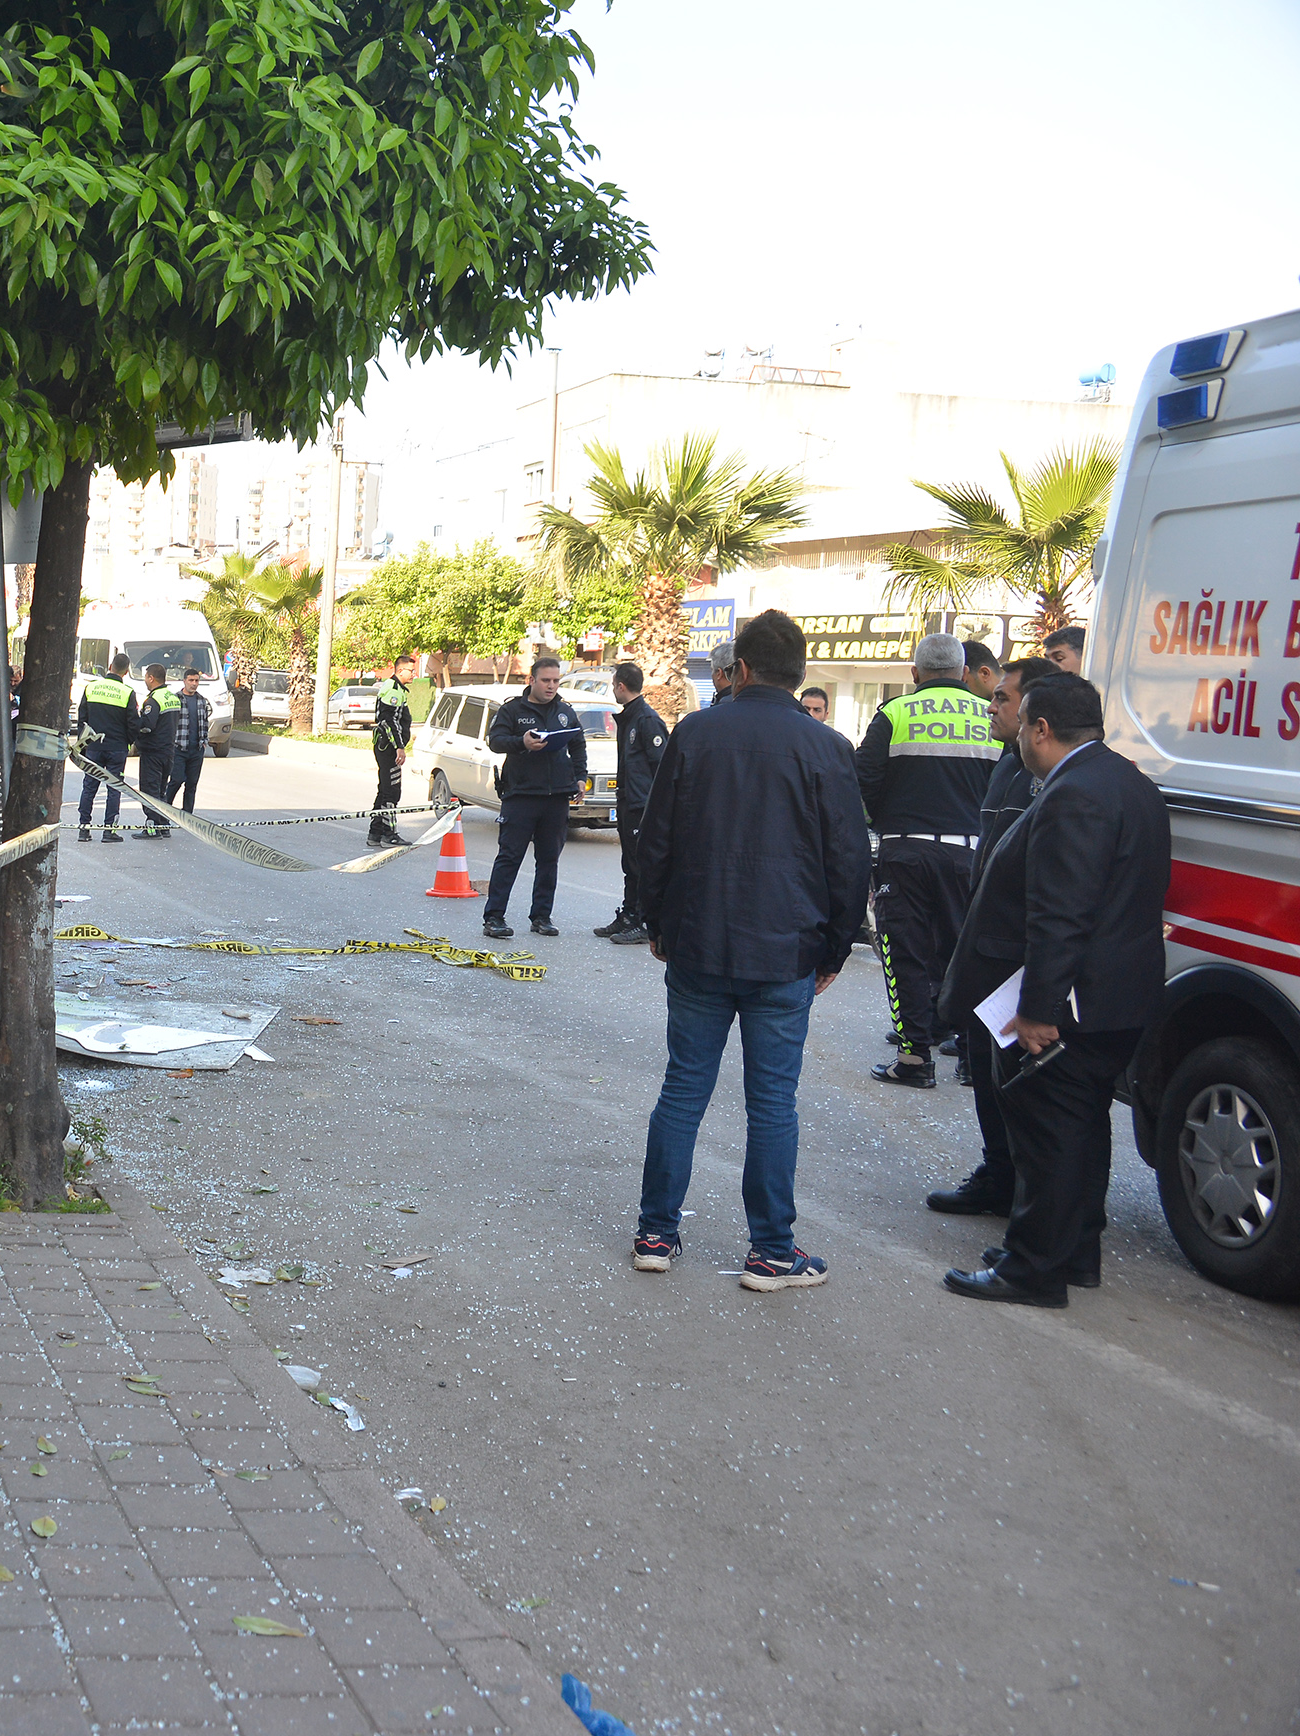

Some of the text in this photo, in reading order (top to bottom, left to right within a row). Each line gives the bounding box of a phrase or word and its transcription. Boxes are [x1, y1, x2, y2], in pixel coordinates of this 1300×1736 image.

[1149, 588, 1268, 657] SAĞLIK
[687, 630, 732, 652] RKET
[816, 640, 832, 659] &
[832, 640, 913, 659] KANEPE
[904, 697, 993, 720] TRAFİK
[1187, 668, 1300, 741] ACİL S
